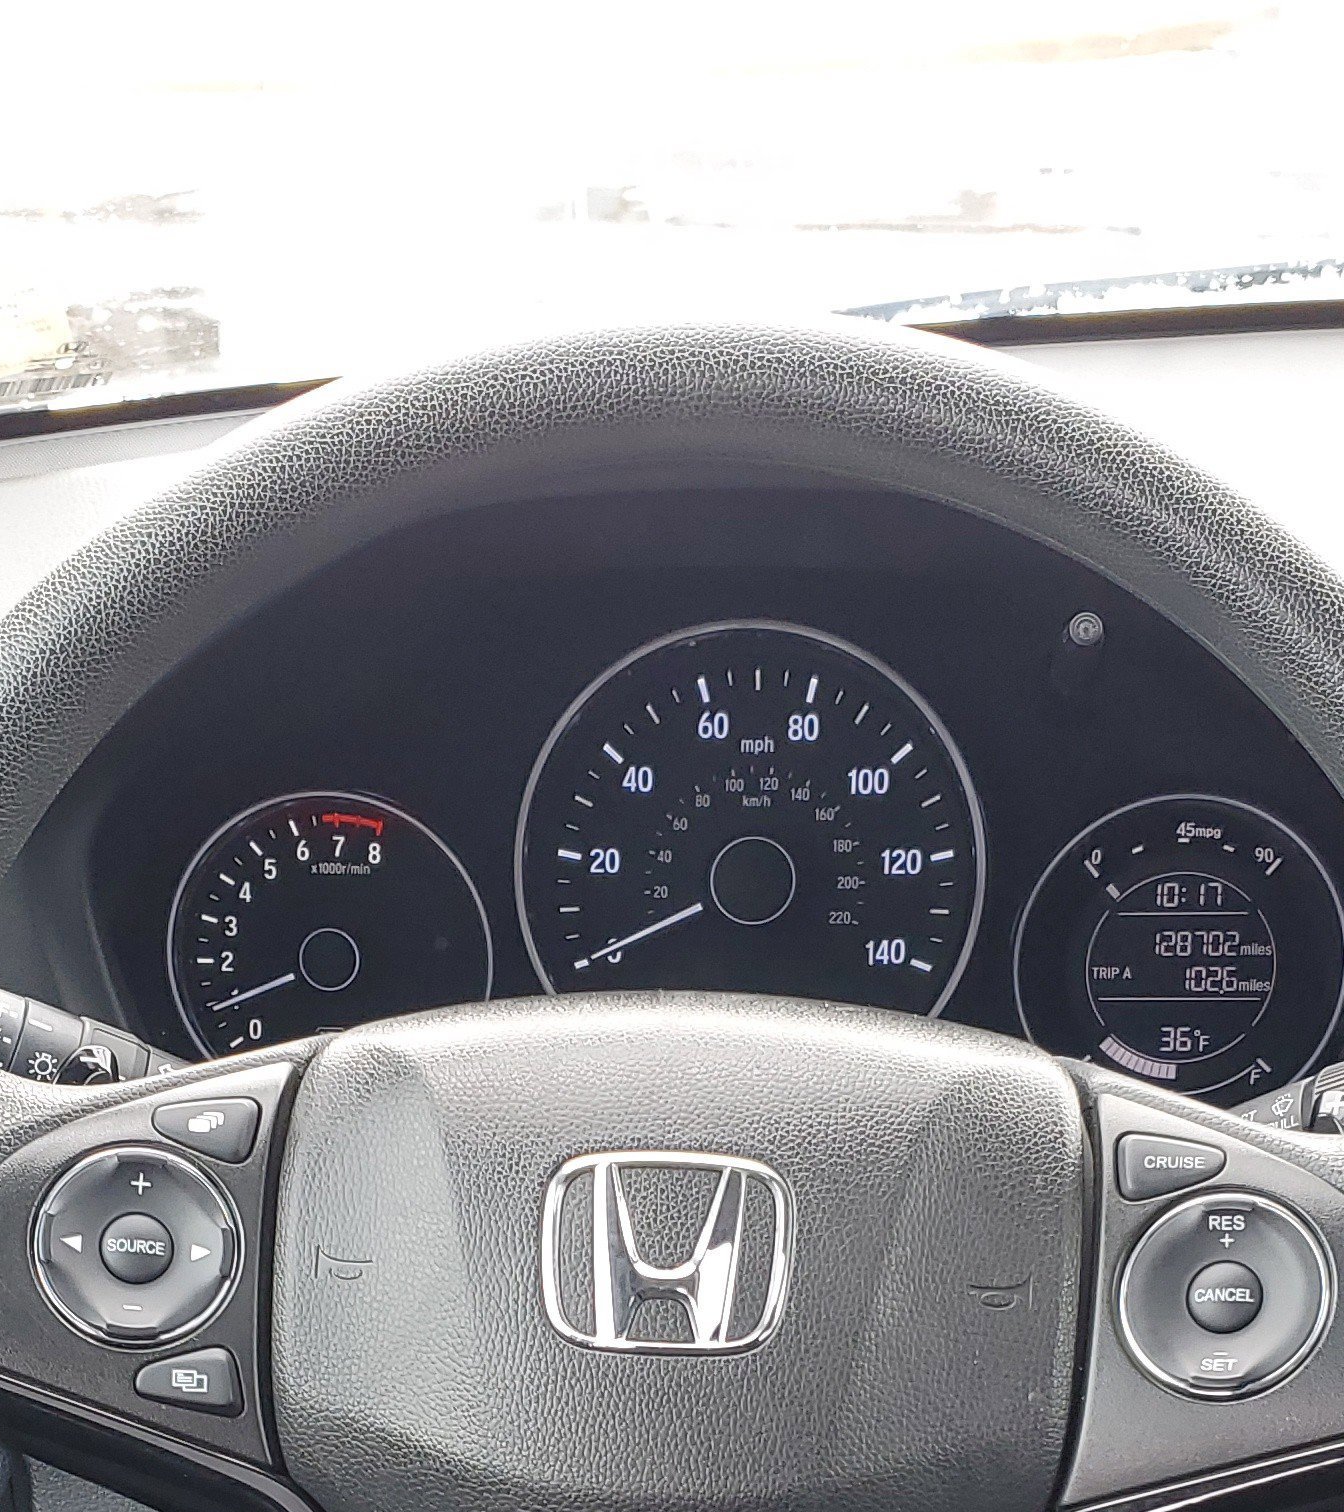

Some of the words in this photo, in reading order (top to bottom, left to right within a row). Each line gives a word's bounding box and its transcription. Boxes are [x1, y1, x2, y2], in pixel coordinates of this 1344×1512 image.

[698, 712, 729, 739] 60
[788, 714, 819, 741] 80
[740, 737, 775, 755] mph
[622, 767, 653, 792] 40
[725, 777, 744, 793] 100
[759, 776, 778, 791] 120
[847, 769, 889, 795] 100
[695, 794, 710, 808] 80
[742, 795, 771, 808] km/h
[790, 787, 810, 802] 140
[814, 808, 834, 822] 160
[673, 818, 688, 832] 60
[296, 840, 309, 861] 6
[332, 836, 344, 857] 7
[368, 843, 381, 864] 8
[832, 839, 853, 853] 180
[590, 849, 620, 873] 20
[657, 850, 672, 864] 40
[881, 849, 922, 876] 120
[1091, 850, 1102, 865] 0
[1255, 848, 1274, 863] 90
[264, 859, 276, 880] 5
[837, 876, 859, 890] 200
[239, 881, 252, 903] 4
[653, 885, 668, 899] 20
[1156, 883, 1223, 908] 10:17
[224, 916, 238, 937] 3
[829, 911, 851, 925] 220
[865, 939, 905, 965] 140
[221, 952, 234, 972] 2
[1091, 967, 1120, 980] TRIP
[1122, 967, 1132, 980] A
[249, 1019, 262, 1039] 0
[1249, 1068, 1261, 1086] F
[1143, 1155, 1206, 1170] CRUISE
[1208, 1215, 1246, 1231] RES
[106, 1238, 167, 1256] SOURCE
[1194, 1288, 1254, 1303] CANCEL
[1200, 1357, 1238, 1372] SET
